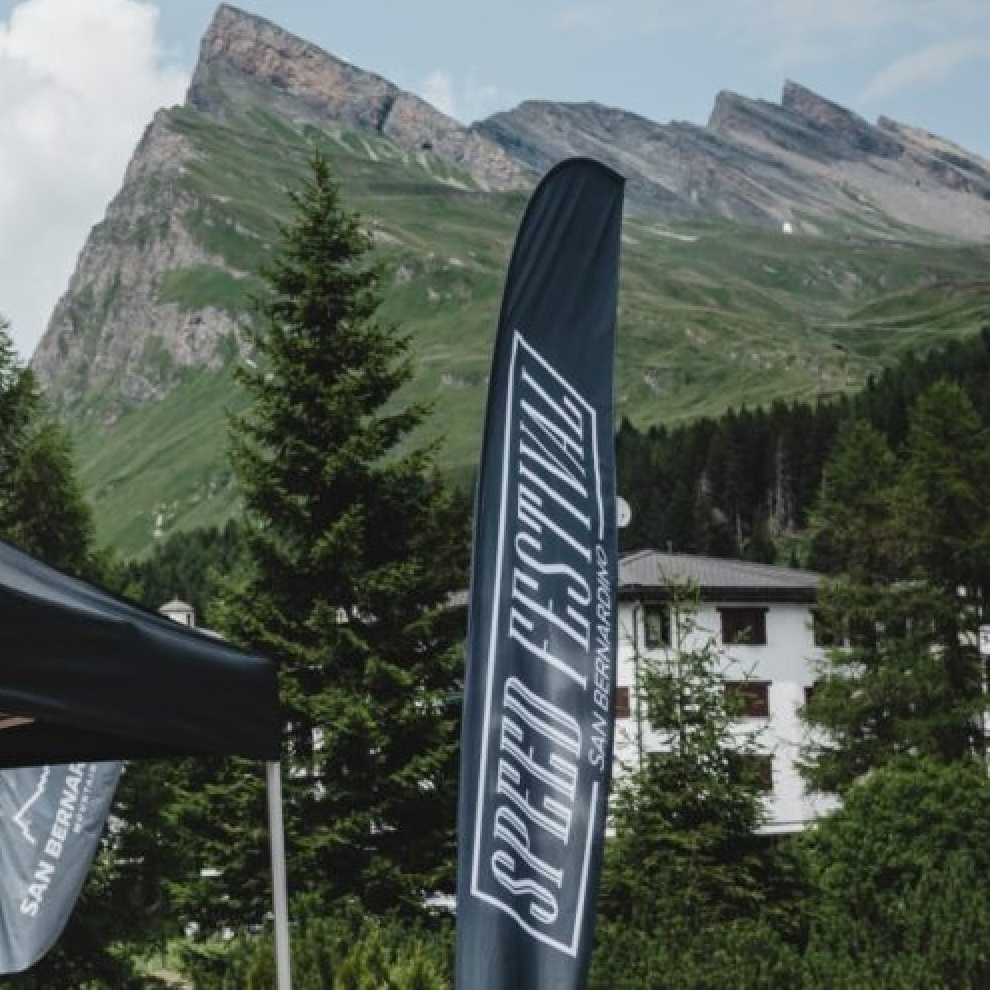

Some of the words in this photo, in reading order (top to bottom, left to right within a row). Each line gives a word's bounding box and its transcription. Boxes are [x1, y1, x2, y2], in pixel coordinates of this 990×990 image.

[509, 366, 592, 691] FESTIVAL
[593, 544, 611, 711] BERNARDINO
[491, 676, 582, 925] SPEED
[588, 712, 609, 771] SAN
[20, 861, 55, 917] SAN
